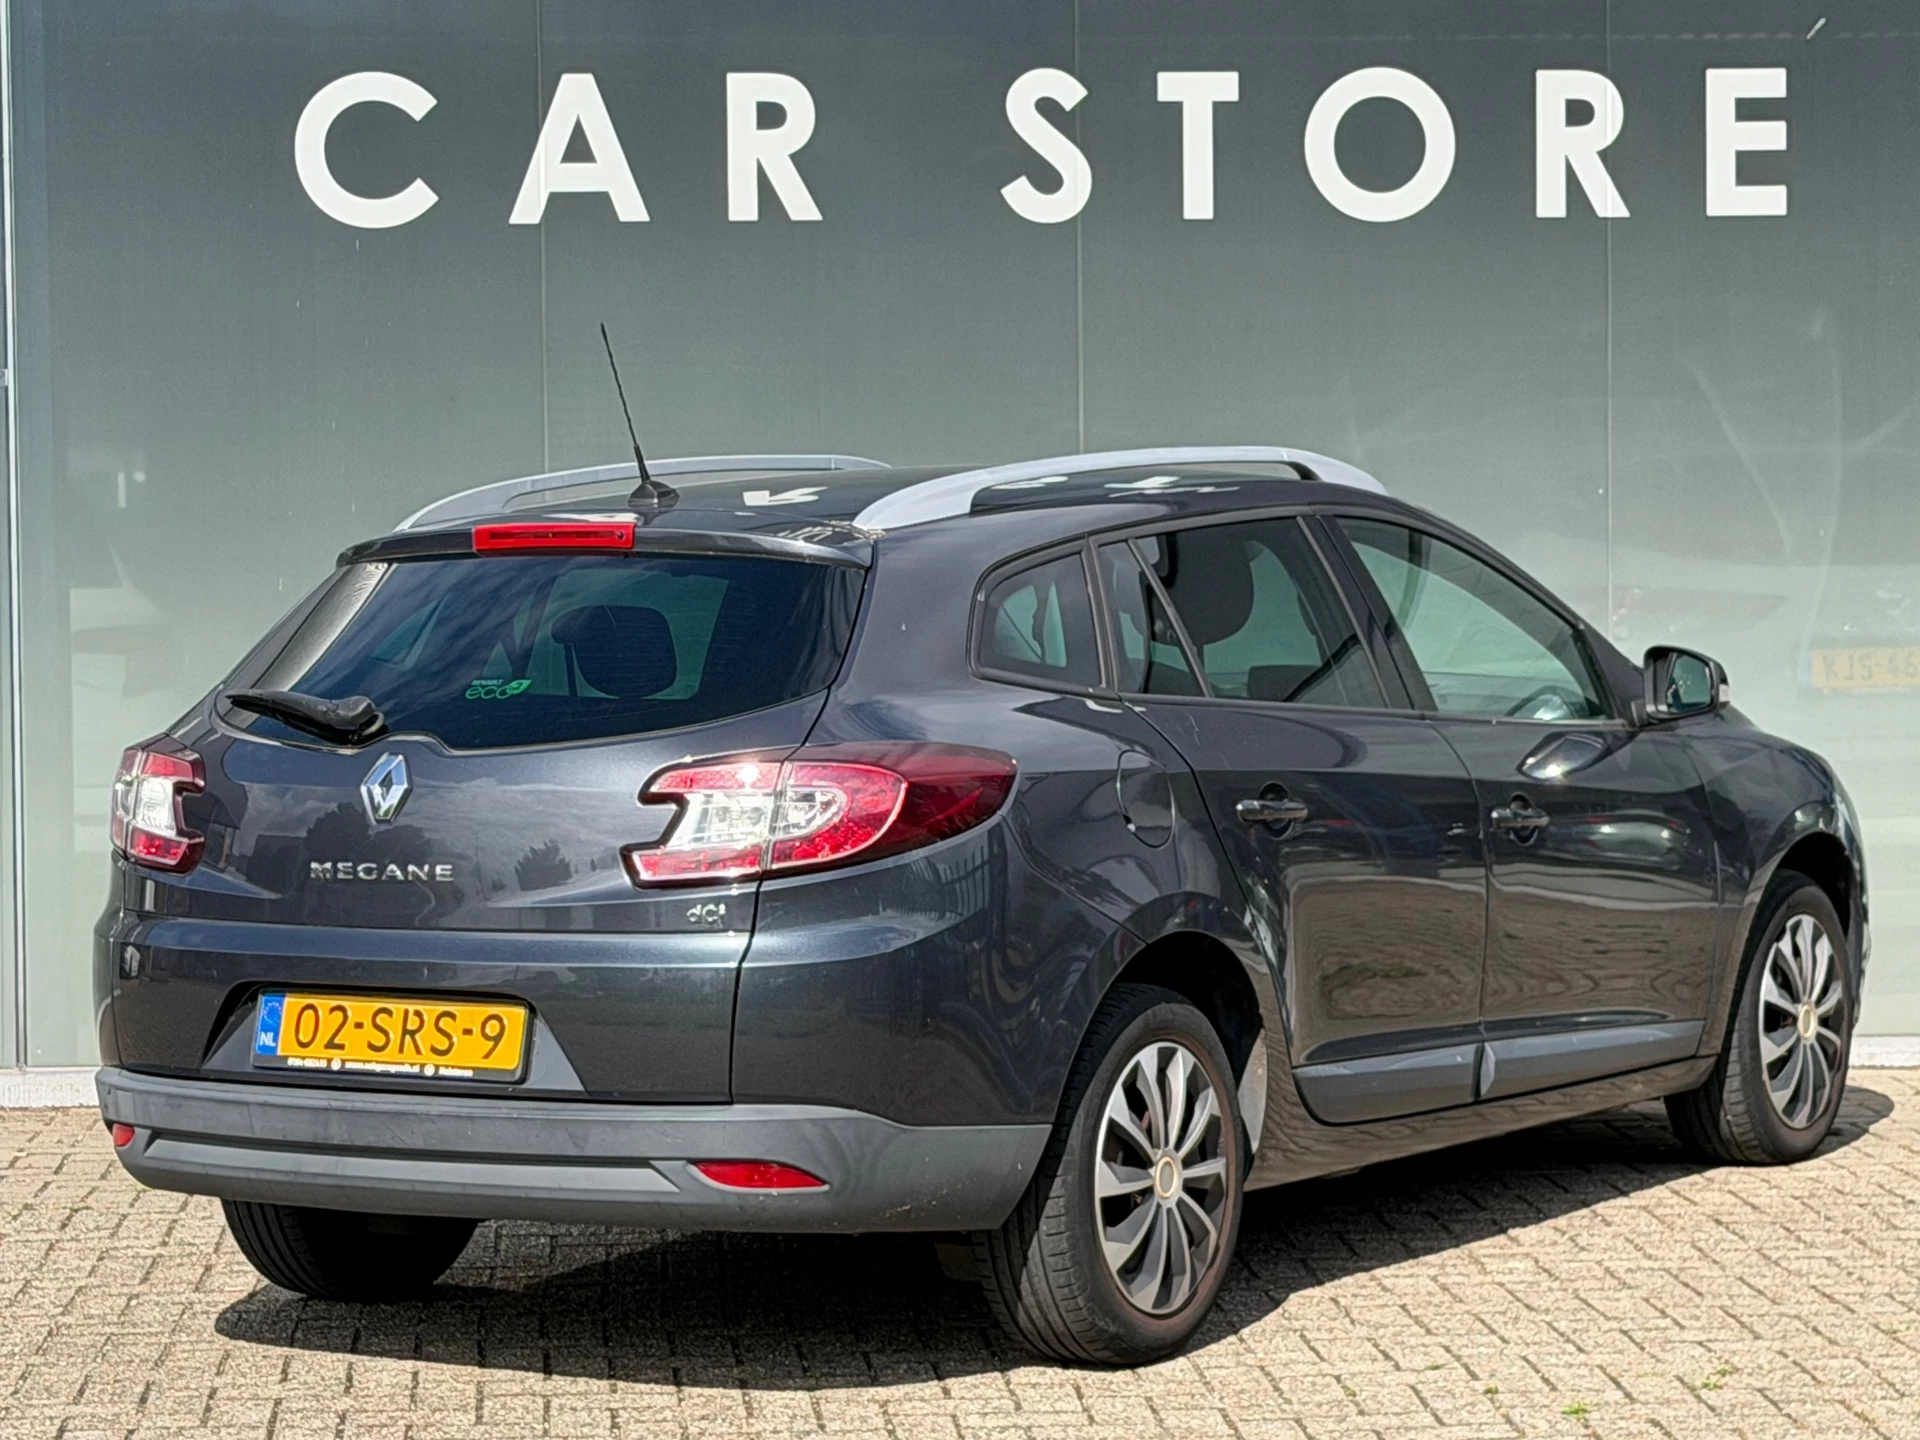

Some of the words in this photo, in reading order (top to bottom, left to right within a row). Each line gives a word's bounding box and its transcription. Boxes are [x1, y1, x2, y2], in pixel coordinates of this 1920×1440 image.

[294, 70, 824, 229] CAR
[999, 66, 1788, 224] STORE
[310, 861, 454, 882] MEGANE
[259, 1031, 276, 1047] NL
[294, 1002, 507, 1060] 02-SRS-9
